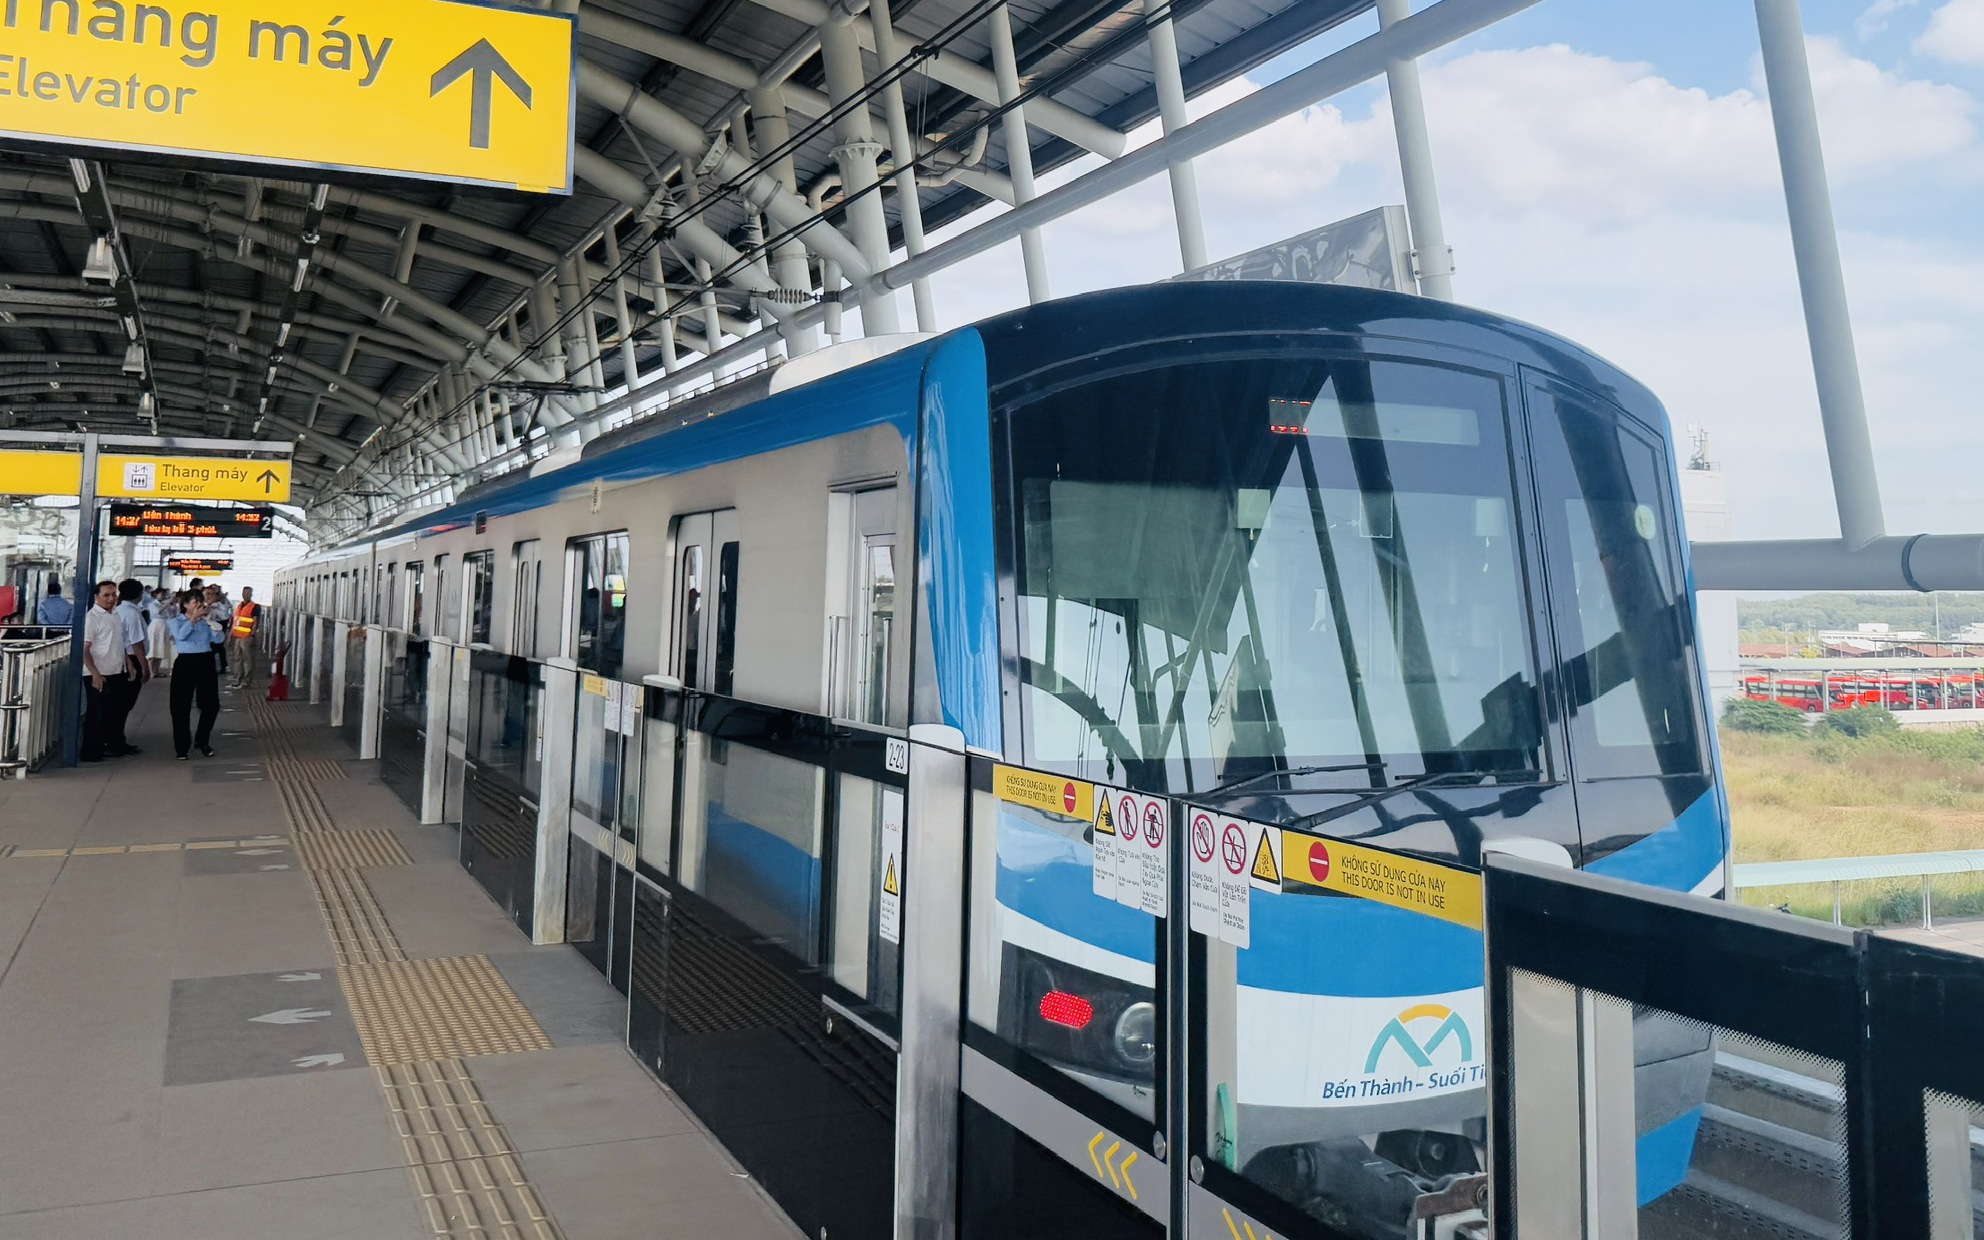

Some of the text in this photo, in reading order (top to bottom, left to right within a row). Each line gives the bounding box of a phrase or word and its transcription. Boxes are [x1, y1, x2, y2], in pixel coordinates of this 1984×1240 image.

[247, 15, 393, 87] máy
[162, 463, 248, 483] Thang máy
[160, 481, 205, 492] Elevator
[261, 516, 272, 531] 2
[889, 742, 905, 770] 2-23
[1341, 854, 1368, 873] KHÔNG
[1341, 871, 1445, 909] THIS DOOR IS NOT IN USE
[1322, 1079, 1356, 1099] Bến
[1360, 1075, 1413, 1097] Thành
[1428, 1066, 1466, 1089] Suối
